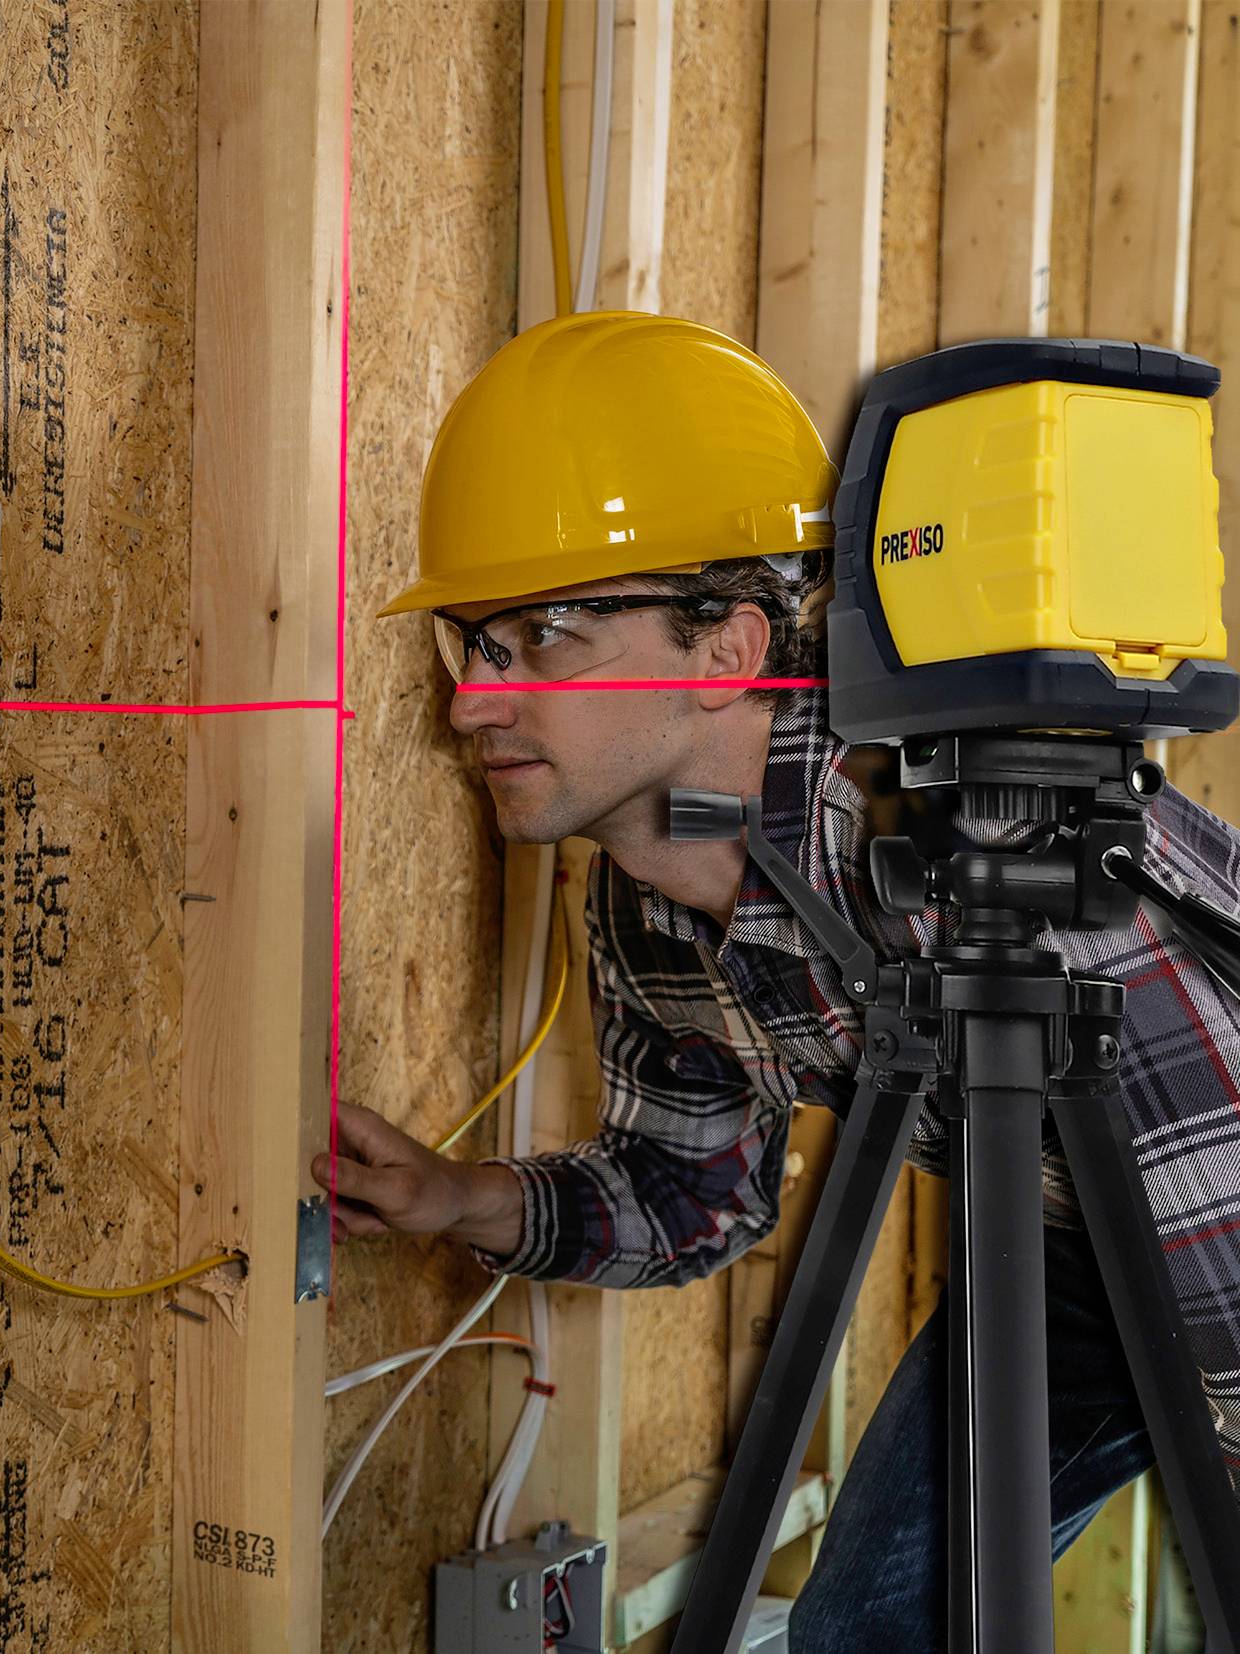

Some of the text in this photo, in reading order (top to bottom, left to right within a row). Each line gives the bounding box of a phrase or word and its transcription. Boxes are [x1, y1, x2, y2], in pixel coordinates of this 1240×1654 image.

[880, 523, 944, 566] PREXISO
[32, 825, 70, 1210] 7/16 CAT
[234, 1530, 276, 1557] 873
[236, 1551, 277, 1567] S-P-F
[236, 1561, 277, 1579] KD-HT
